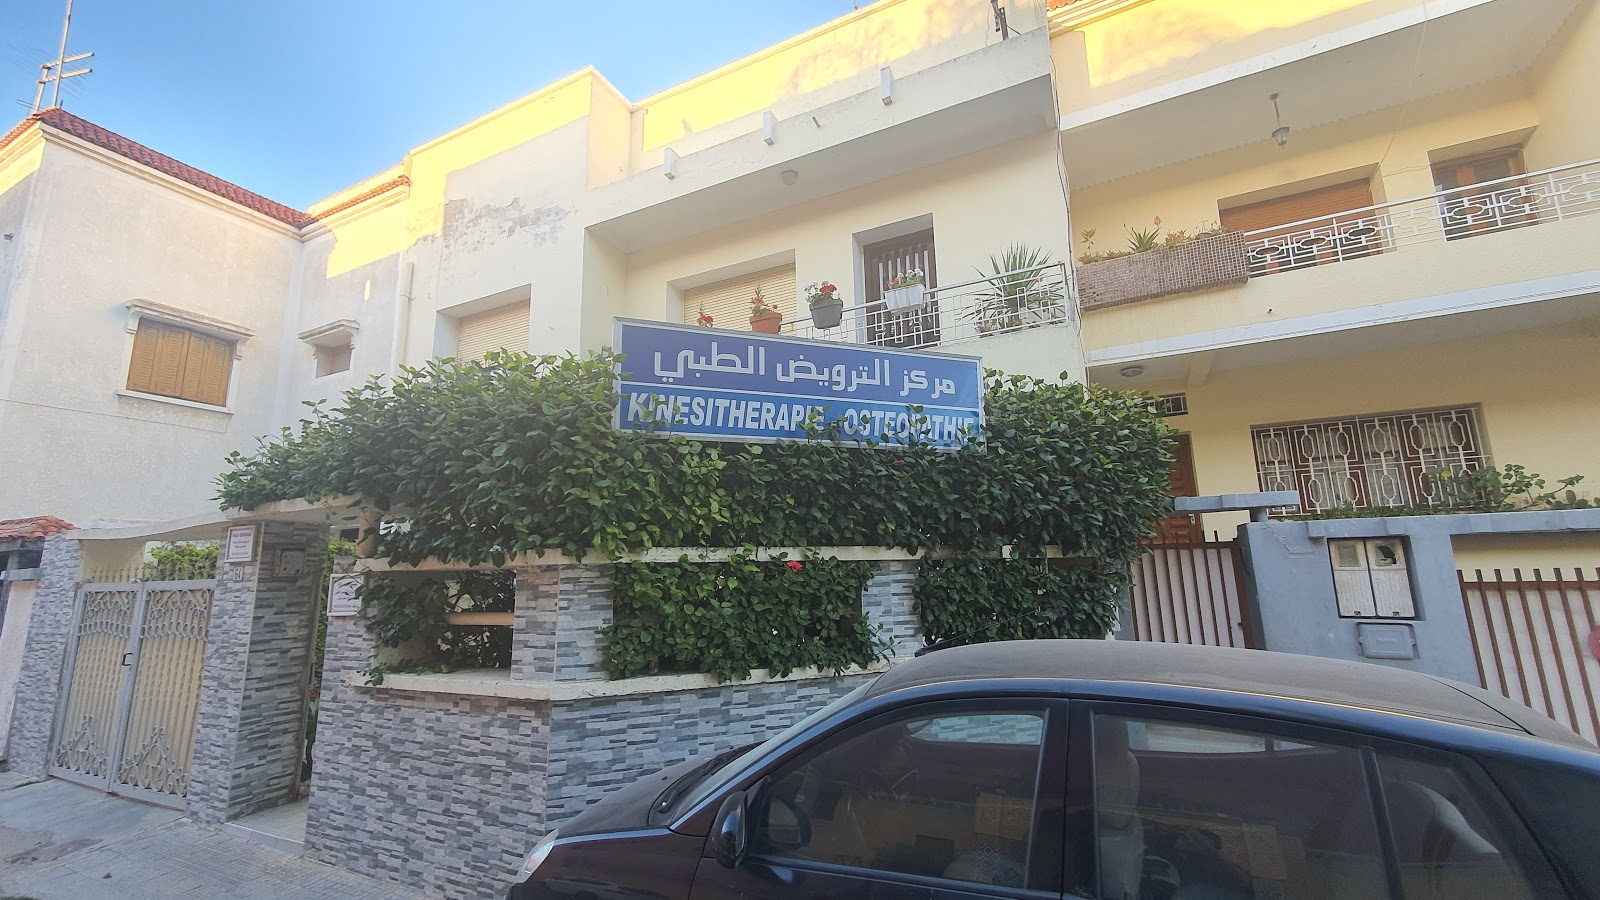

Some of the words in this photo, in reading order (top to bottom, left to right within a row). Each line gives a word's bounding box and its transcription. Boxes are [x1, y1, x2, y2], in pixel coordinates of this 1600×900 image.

[653, 341, 765, 382] الطبي
[776, 354, 890, 391] الترويض
[900, 368, 956, 399] مركز
[627, 391, 826, 433] KINESITHERAPIE
